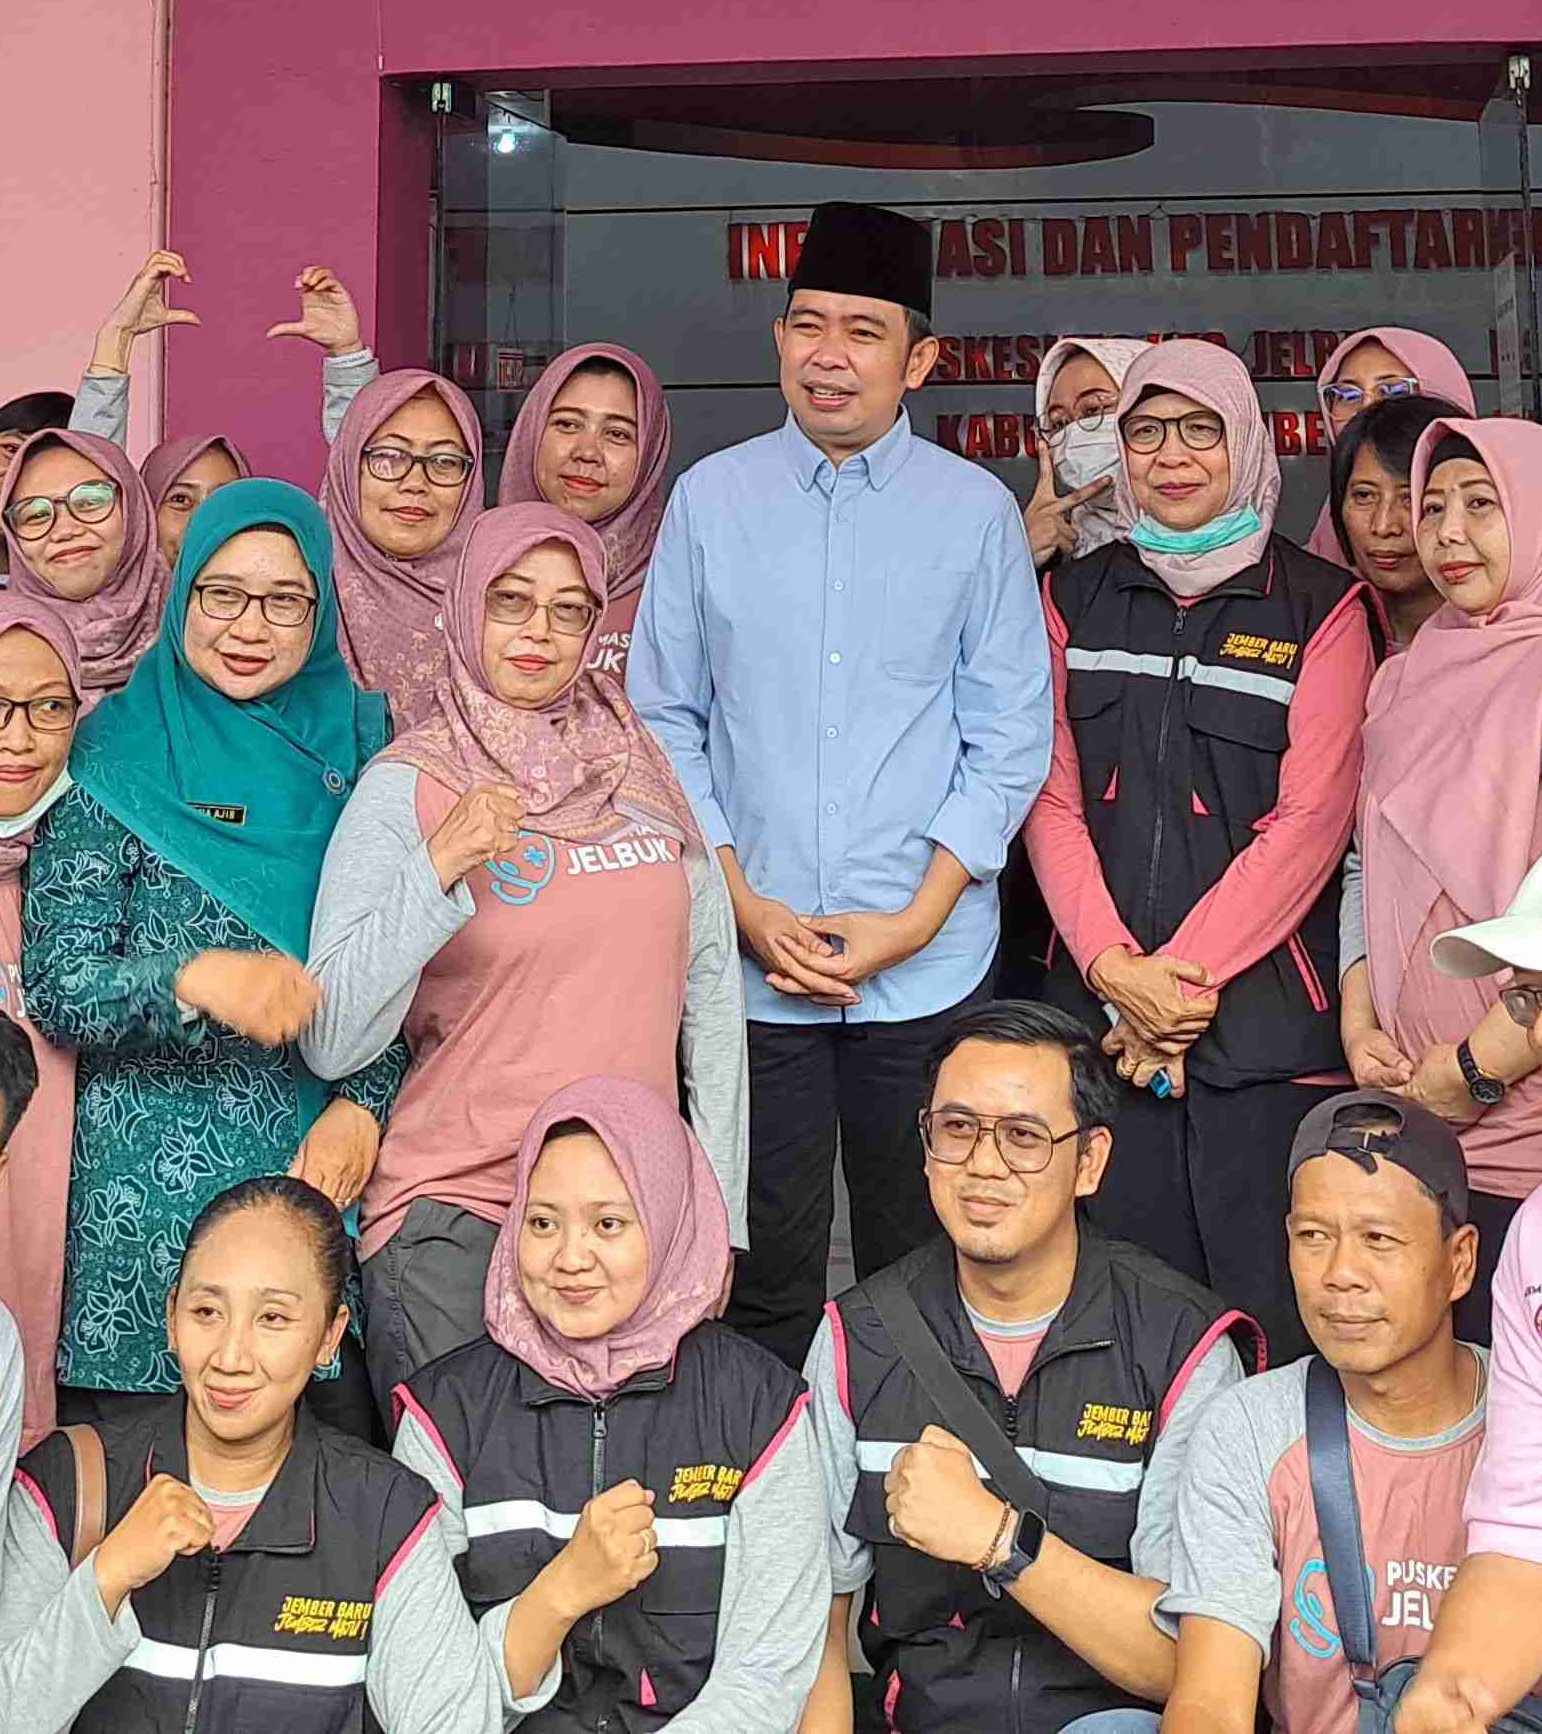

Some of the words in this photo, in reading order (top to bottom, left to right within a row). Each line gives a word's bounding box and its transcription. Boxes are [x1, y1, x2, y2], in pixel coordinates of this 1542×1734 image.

[1040, 213, 1155, 278] DAN
[567, 837, 676, 875] JELBUK
[1082, 1403, 1130, 1426] JEMBER
[717, 1465, 744, 1486] BAR
[282, 1595, 336, 1618] JEMBER
[336, 1601, 373, 1620] BARU
